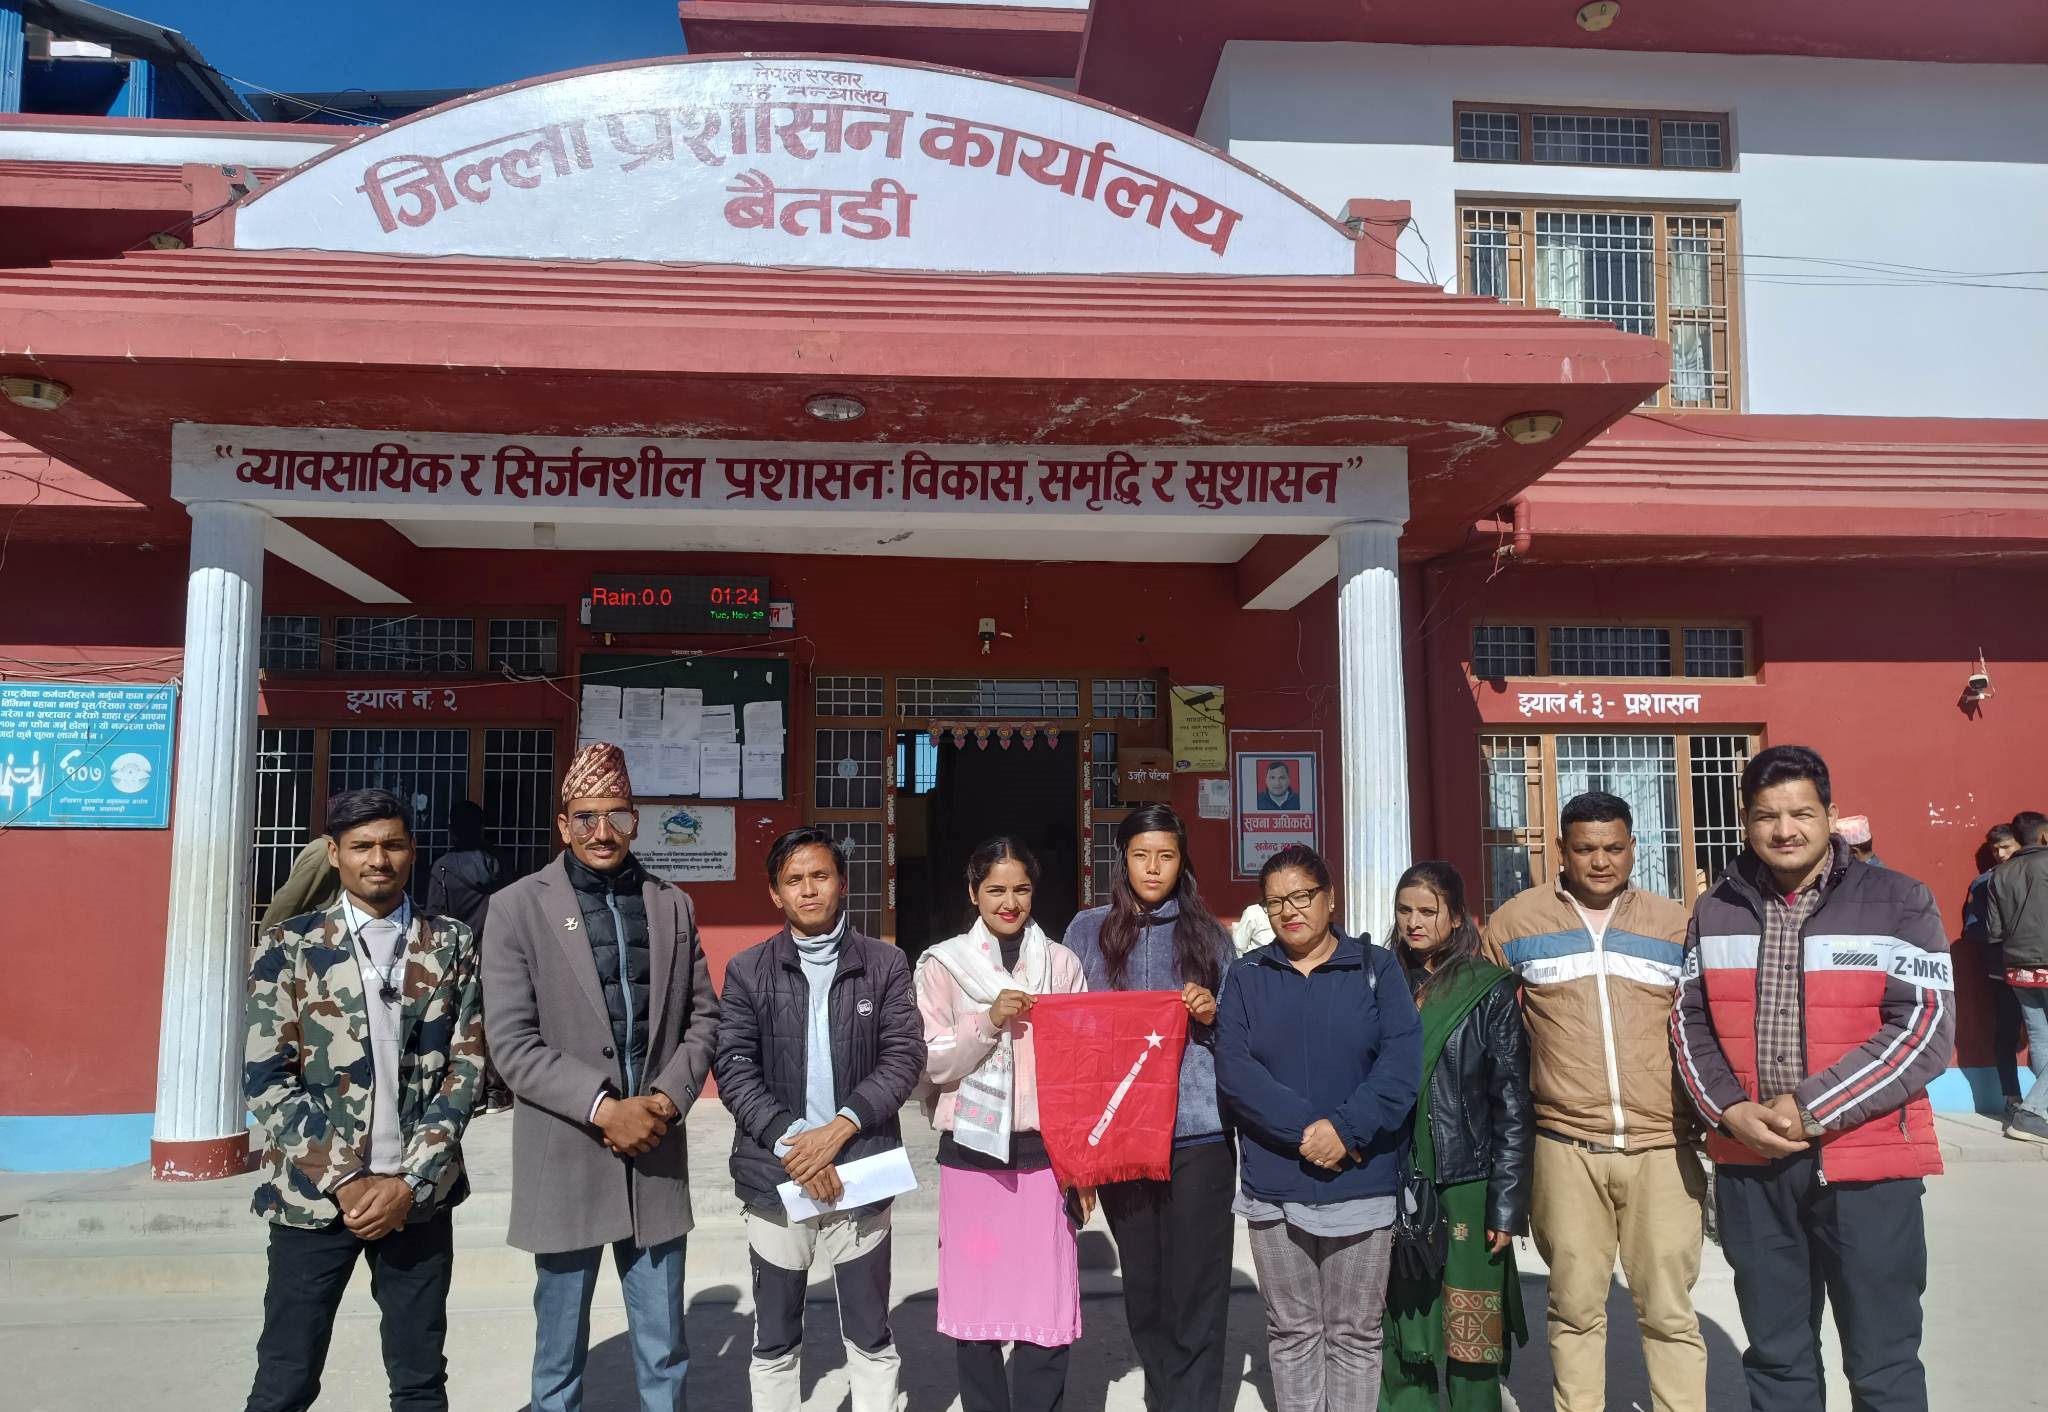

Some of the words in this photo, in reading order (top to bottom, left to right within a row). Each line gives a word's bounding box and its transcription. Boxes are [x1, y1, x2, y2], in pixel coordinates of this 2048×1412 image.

[806, 69, 863, 88] सरकार
[355, 118, 593, 234] जिल्ला
[599, 102, 914, 173] प्रशासन
[919, 112, 1243, 257] कार्यालय
[723, 168, 918, 240] बैतडी
[460, 454, 485, 497] र
[493, 445, 706, 500] सिर्जनशील
[1038, 451, 1147, 511] समृद्धि
[1152, 460, 1177, 503] र
[732, 611, 749, 619] Nov
[443, 689, 457, 711] २
[1518, 692, 1567, 716] झ्याल
[1624, 693, 1701, 716] प्रशासन
[66, 766, 102, 782] १०७
[1272, 814, 1313, 830] अधिकारी
